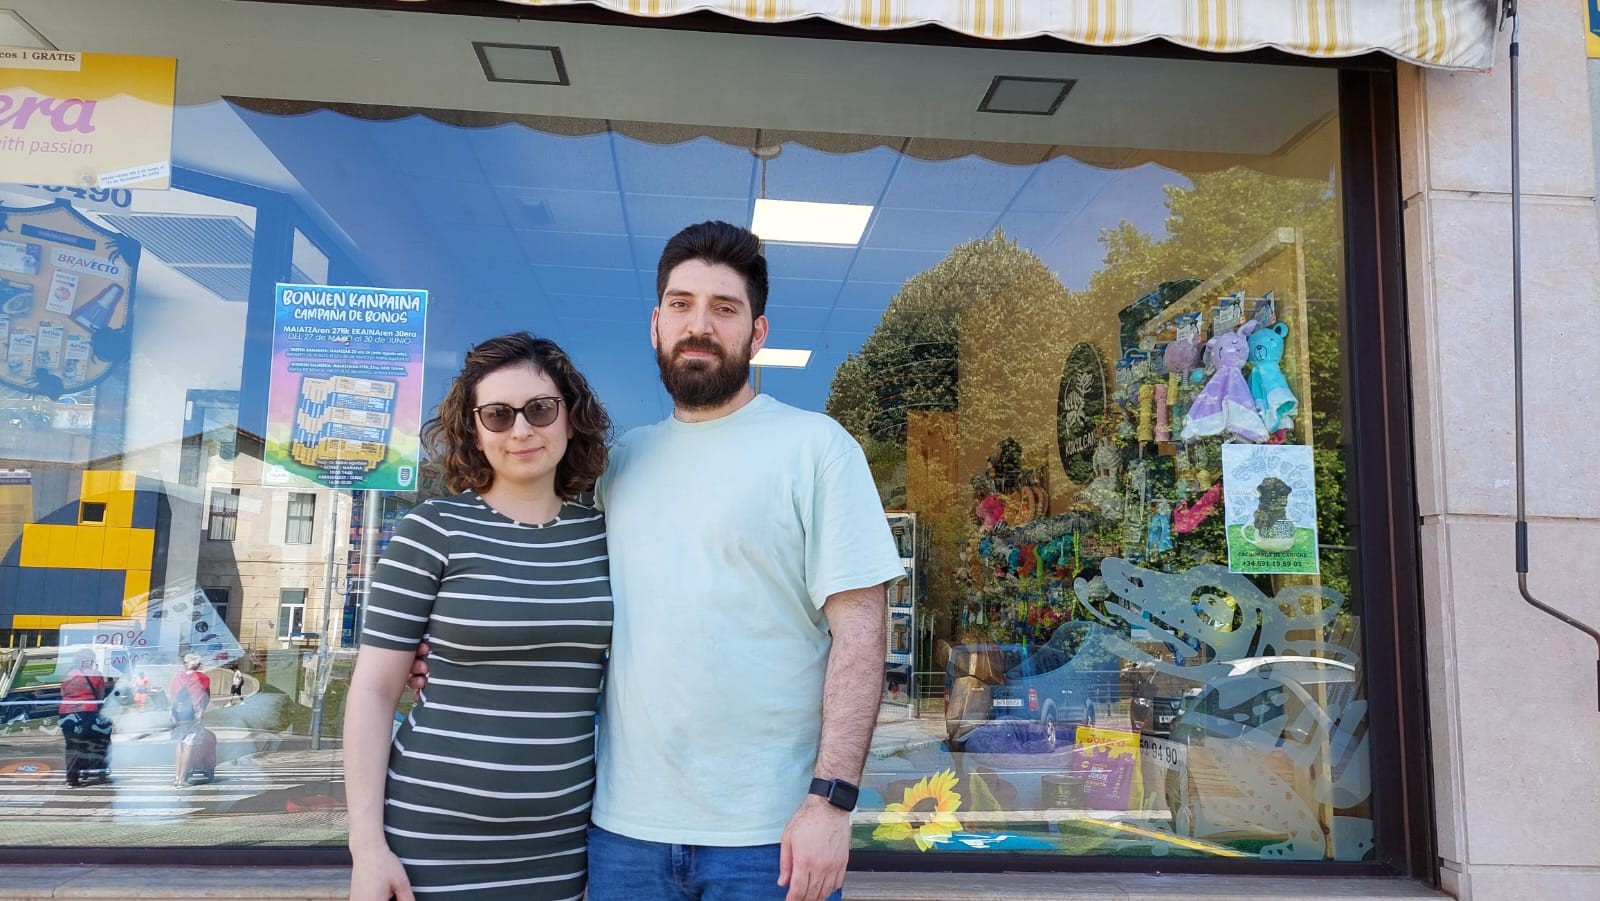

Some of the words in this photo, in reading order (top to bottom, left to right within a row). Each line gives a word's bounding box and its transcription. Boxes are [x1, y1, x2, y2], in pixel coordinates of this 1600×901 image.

[22, 51, 28, 60] 1
[32, 52, 76, 62] GRATIS
[29, 138, 94, 156] passion
[57, 253, 119, 275] BRAVECTO
[282, 289, 347, 309] BONUEN
[349, 292, 420, 311] KANPAINA
[349, 310, 363, 321] DE
[365, 311, 408, 323] BONOS
[283, 325, 330, 334] MAIATZAren
[351, 328, 393, 337] EKAINAren
[387, 337, 412, 345] JUNIO
[1151, 742, 1163, 761] 94
[1165, 746, 1178, 765] 90
